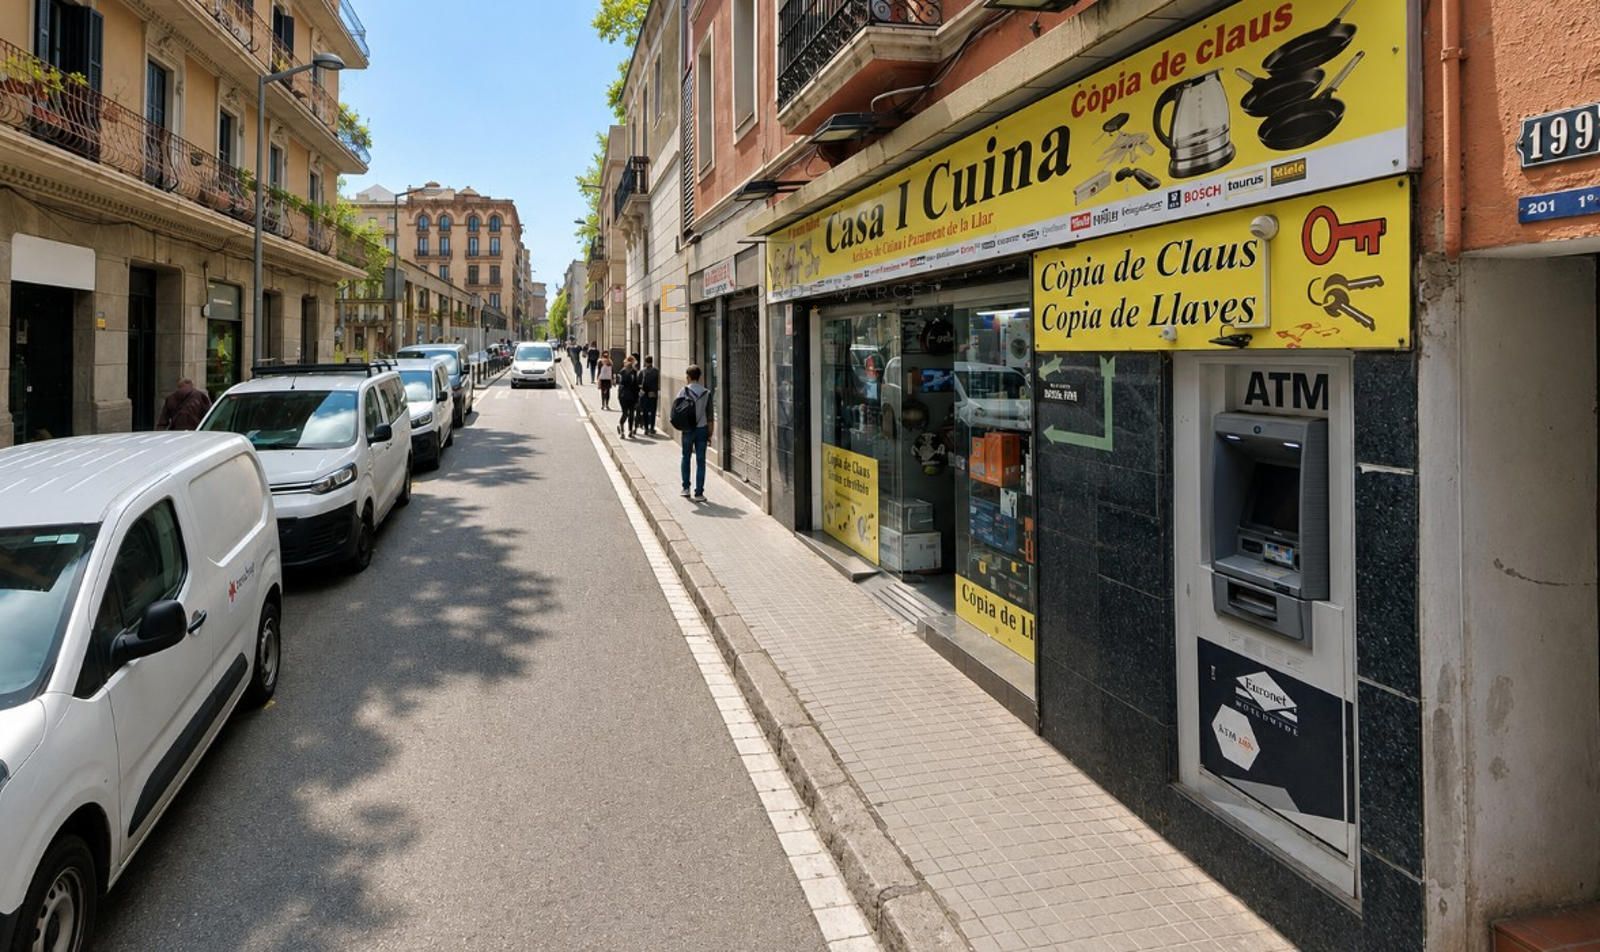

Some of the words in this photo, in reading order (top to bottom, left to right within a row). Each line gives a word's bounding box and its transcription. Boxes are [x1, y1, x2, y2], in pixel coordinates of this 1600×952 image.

[1150, 49, 1187, 86] de
[1195, 3, 1294, 65] claus
[1529, 111, 1593, 159] 199
[1227, 174, 1264, 191] taurus
[1273, 161, 1305, 178] Miele
[825, 203, 885, 254] Casa
[895, 180, 911, 231] I
[922, 124, 1072, 220] Cuina
[1184, 184, 1221, 203] BOSCH
[1527, 199, 1555, 215] 201
[946, 221, 958, 236] de
[960, 217, 969, 232] la
[971, 211, 994, 229] Llar
[1040, 255, 1105, 297] Còpia
[1114, 246, 1146, 282] de
[1156, 237, 1258, 277] Claus
[1041, 299, 1101, 338] Copia
[1110, 294, 1140, 328] de
[1147, 293, 1257, 328] Llaves
[1244, 371, 1328, 410] ATM
[1000, 605, 1016, 631] de
[1245, 677, 1288, 707] Euronet
